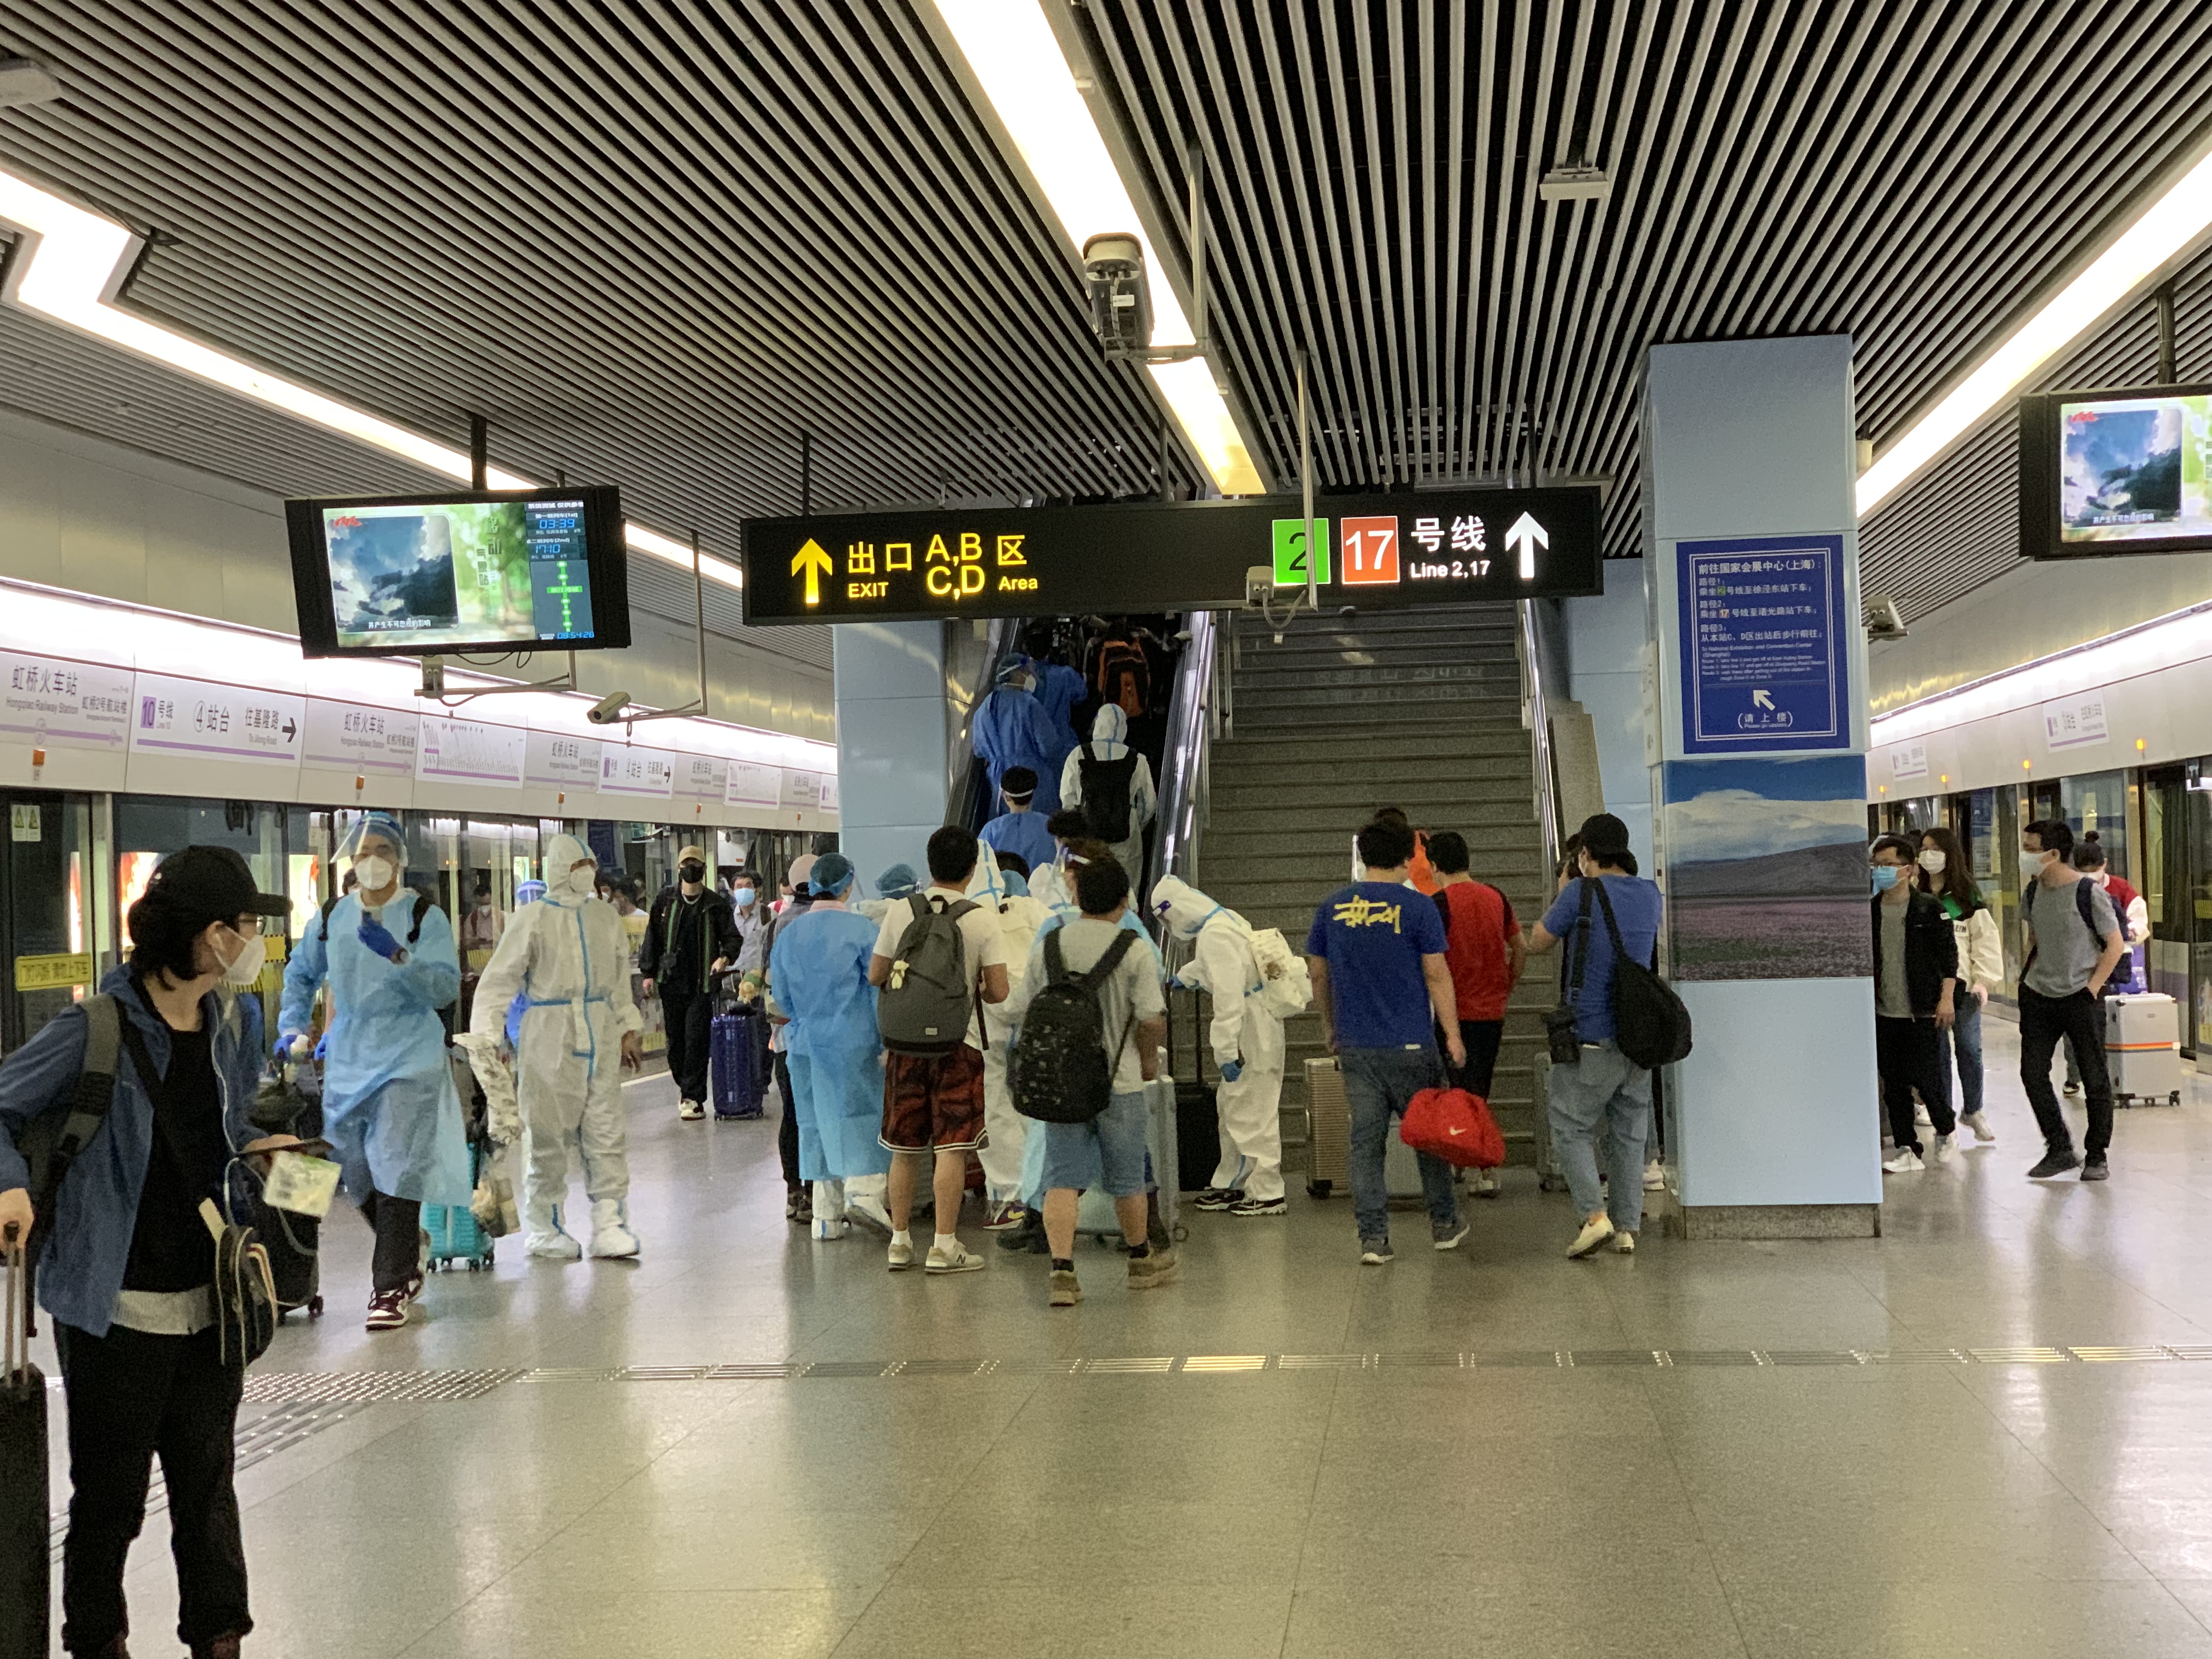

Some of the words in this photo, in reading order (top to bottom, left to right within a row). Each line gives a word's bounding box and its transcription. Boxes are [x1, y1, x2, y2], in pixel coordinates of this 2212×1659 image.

[539, 518, 575, 529] 03:39
[535, 544, 561, 554] 17:10
[848, 541, 912, 574] 出口
[926, 532, 983, 566] A,B
[997, 534, 1028, 566] 区
[1288, 532, 1308, 572] 2
[1345, 529, 1395, 571] 17
[1410, 515, 1487, 552] 号线
[1410, 562, 1448, 579] Line
[1452, 560, 1491, 579] 2,17
[848, 582, 889, 598] EXIT
[927, 565, 985, 601] C,D
[998, 575, 1039, 590] Area
[368, 618, 431, 629] 并产生不可忽视的影响
[12, 664, 78, 697] 虹桥火车站
[35, 699, 58, 715] Railway
[59, 702, 78, 714] Station
[82, 695, 127, 714] 虹桥2号航站楼
[157, 700, 173, 719] 号线
[345, 712, 385, 735] 虹桥火车站
